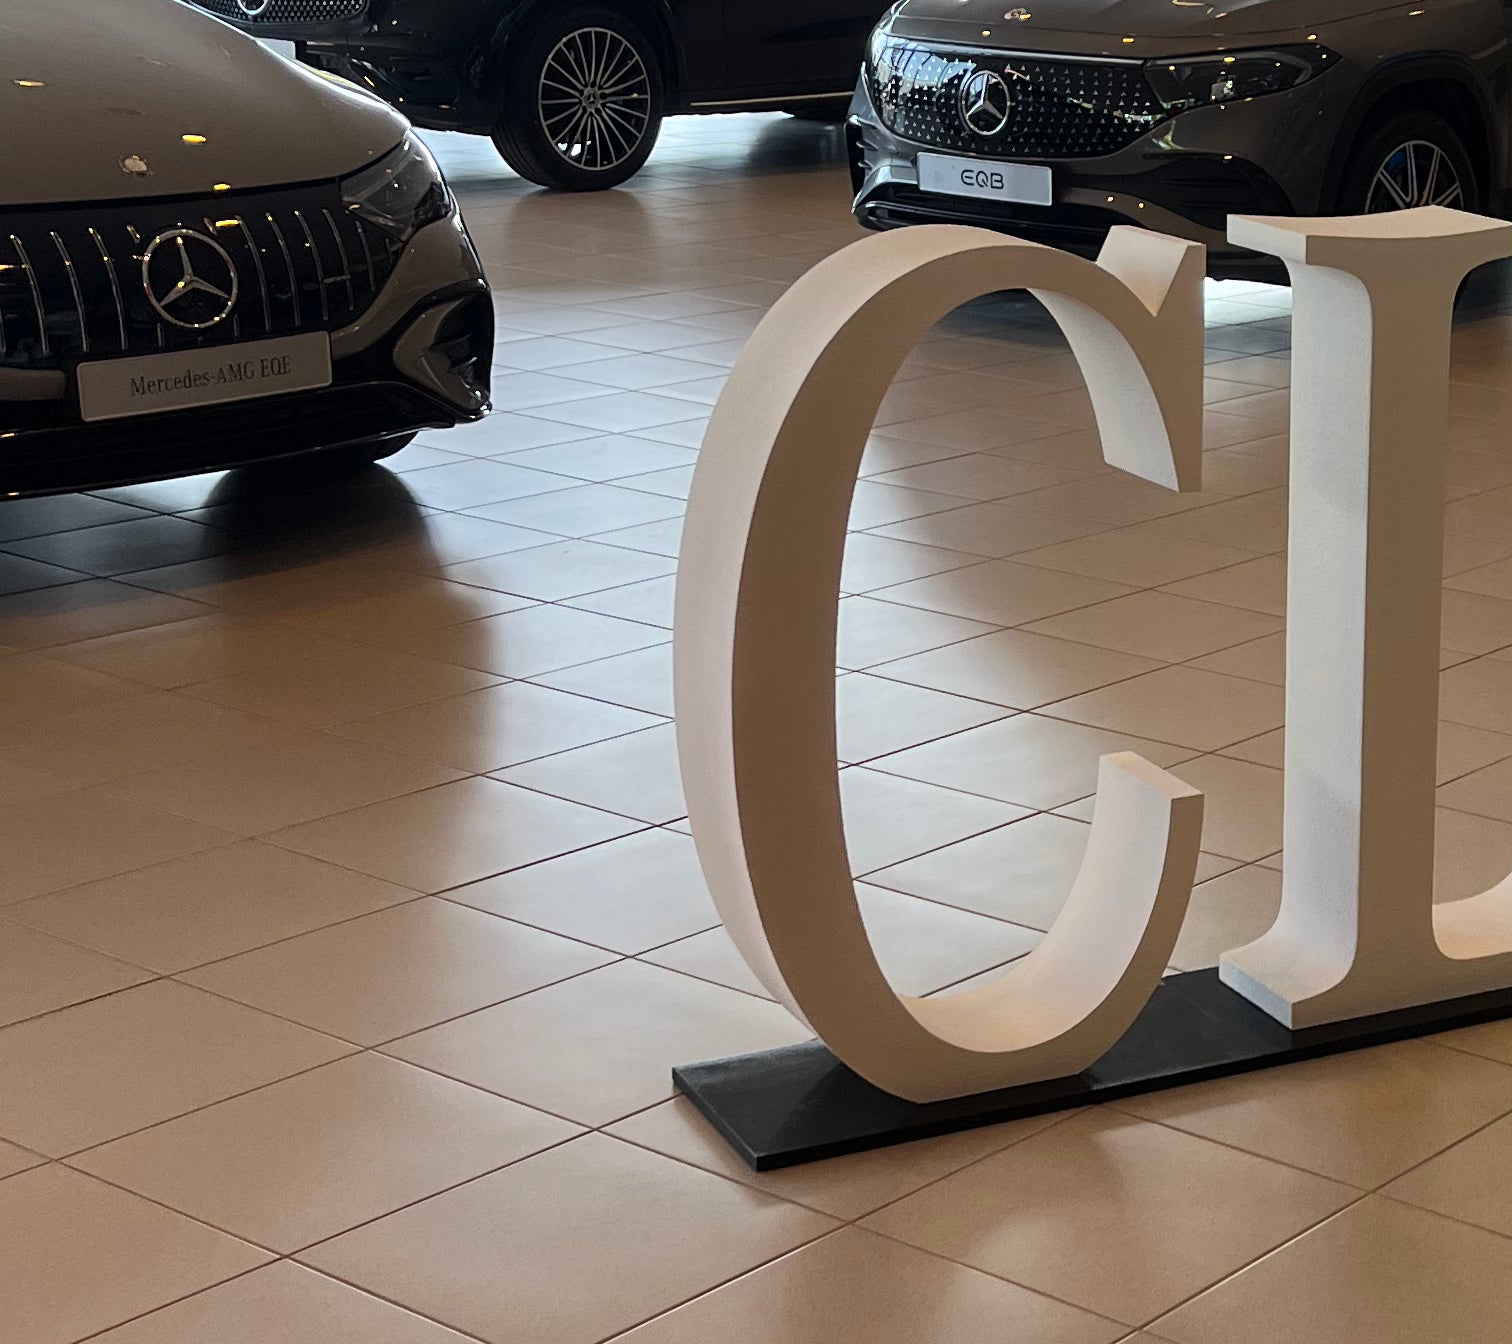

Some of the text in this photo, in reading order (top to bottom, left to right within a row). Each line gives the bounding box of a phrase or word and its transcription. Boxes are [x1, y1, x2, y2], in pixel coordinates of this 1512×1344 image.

[961, 169, 1004, 189] EQB
[130, 356, 292, 396] Mercedes-AMG EQE
